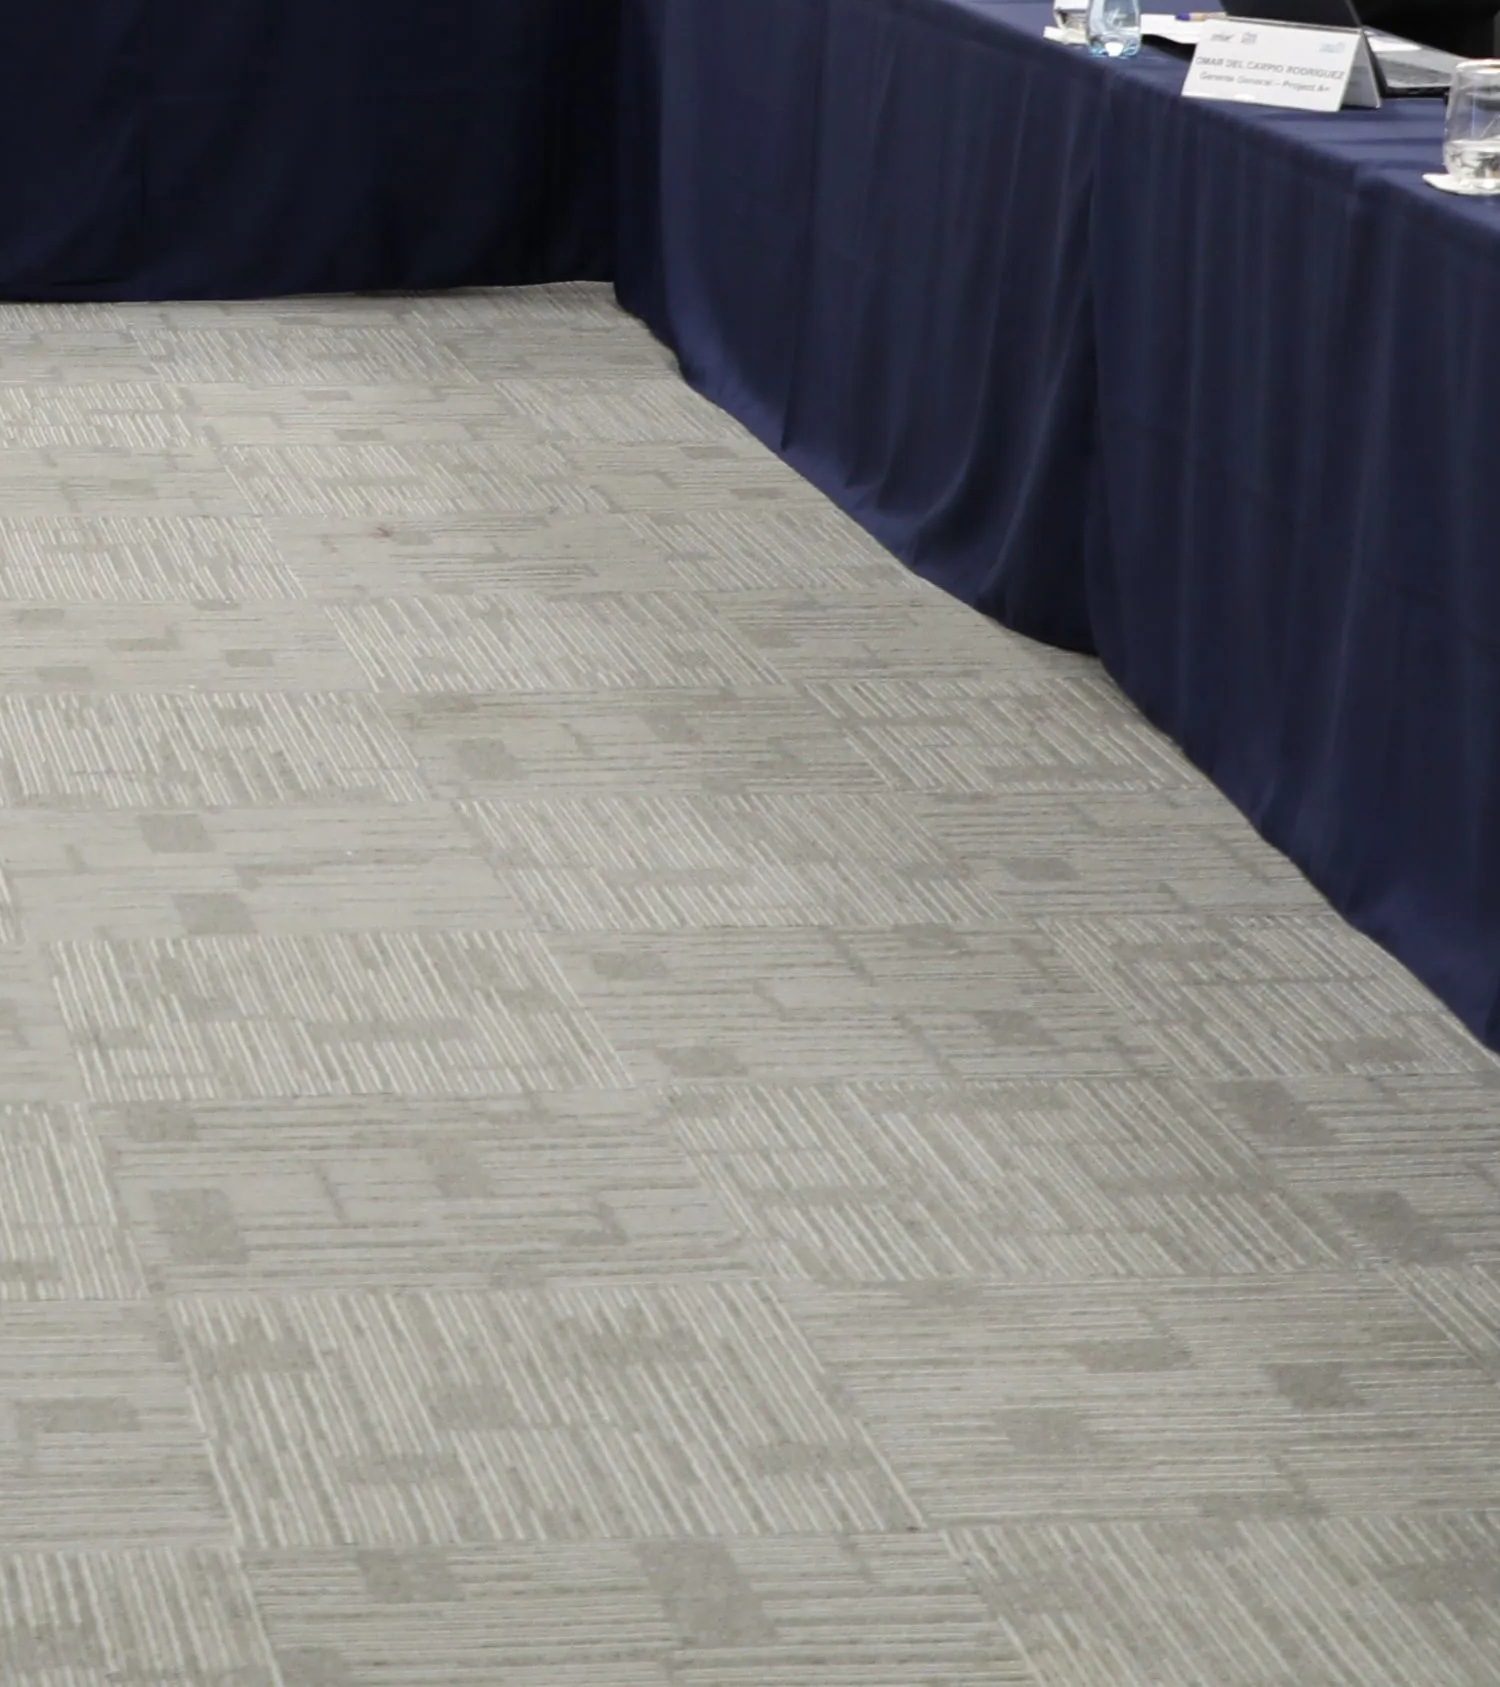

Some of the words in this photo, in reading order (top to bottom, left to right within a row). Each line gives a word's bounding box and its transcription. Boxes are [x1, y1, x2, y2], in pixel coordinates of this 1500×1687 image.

[1195, 56, 1224, 66] OMAR
[1225, 60, 1245, 68] DEL
[1246, 61, 1284, 73] CARPIO
[1285, 65, 1345, 79] RODRIGUEZ
